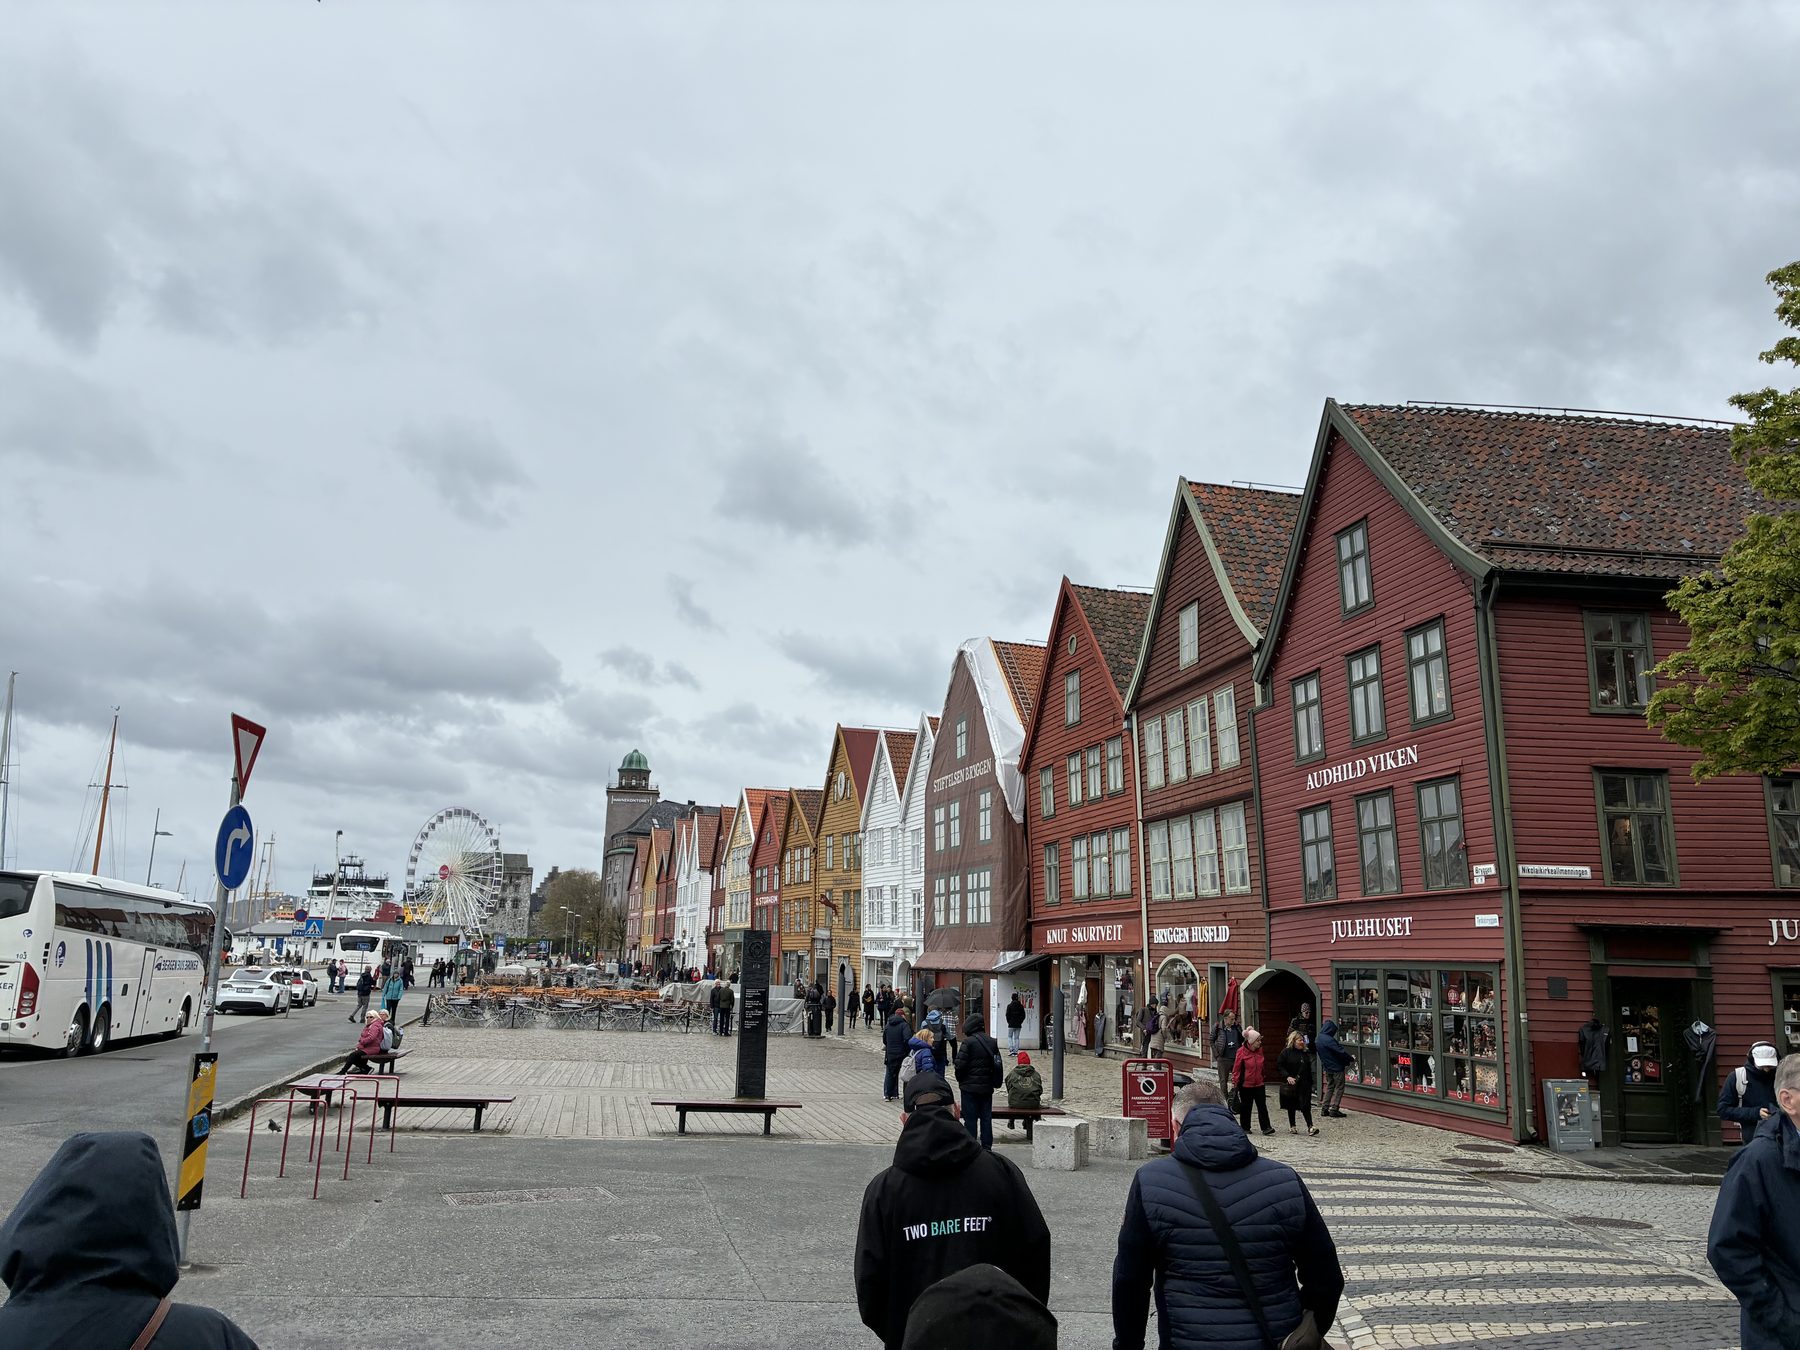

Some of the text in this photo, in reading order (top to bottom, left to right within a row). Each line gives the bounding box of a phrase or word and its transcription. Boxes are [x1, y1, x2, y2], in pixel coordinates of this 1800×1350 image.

[933, 757, 992, 793] STIFTELSEN BRYGGEN
[1306, 744, 1418, 791] AUDHILD VIKEN
[1475, 865, 1493, 875] Bryggen
[1046, 925, 1123, 944] KNUT SKURTVEIT
[1153, 925, 1230, 944] BRYGGEN HUSFLID
[1331, 916, 1413, 944] JULEHUSET
[902, 1223, 928, 1241] TWO
[931, 1218, 961, 1237] BARE
